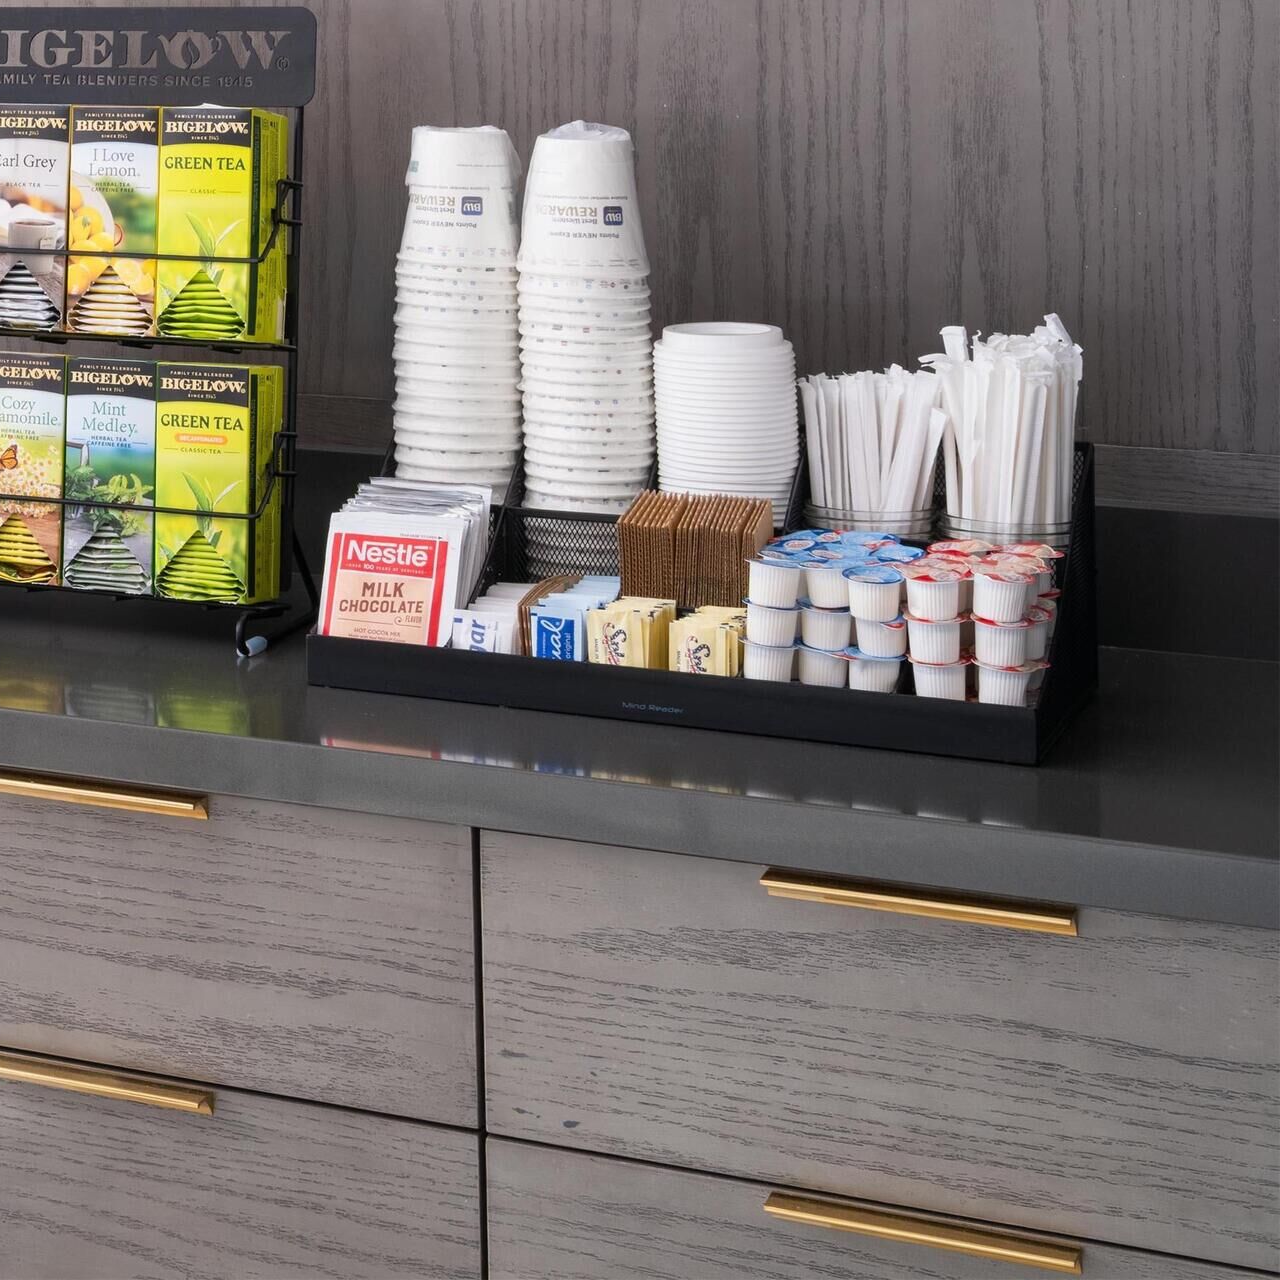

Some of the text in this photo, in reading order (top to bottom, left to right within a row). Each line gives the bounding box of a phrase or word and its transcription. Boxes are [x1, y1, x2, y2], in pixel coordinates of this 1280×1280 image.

[43, 74, 71, 85] TEA
[77, 74, 158, 87] BLENDERS
[164, 75, 210, 87] SINCE
[75, 119, 156, 132] BIGELOW
[165, 121, 248, 134] BIGELOW
[93, 148, 135, 162] I Love
[23, 154, 57, 173] Grey
[164, 156, 246, 171] GREEN TEA
[441, 206, 455, 214] Best
[463, 203, 481, 212] BW
[605, 212, 622, 222] BW
[456, 221, 477, 229] Points
[70, 370, 153, 387] BIGELOW
[160, 377, 246, 394] BIGELOW
[1, 396, 36, 415] Cozy
[92, 401, 127, 417] Mint
[161, 413, 244, 431] GREEN TEA
[361, 581, 405, 598] MILK
[338, 599, 424, 614] CHOCOLATE
[367, 628, 387, 636] COCOA
[540, 618, 566, 660] ual
